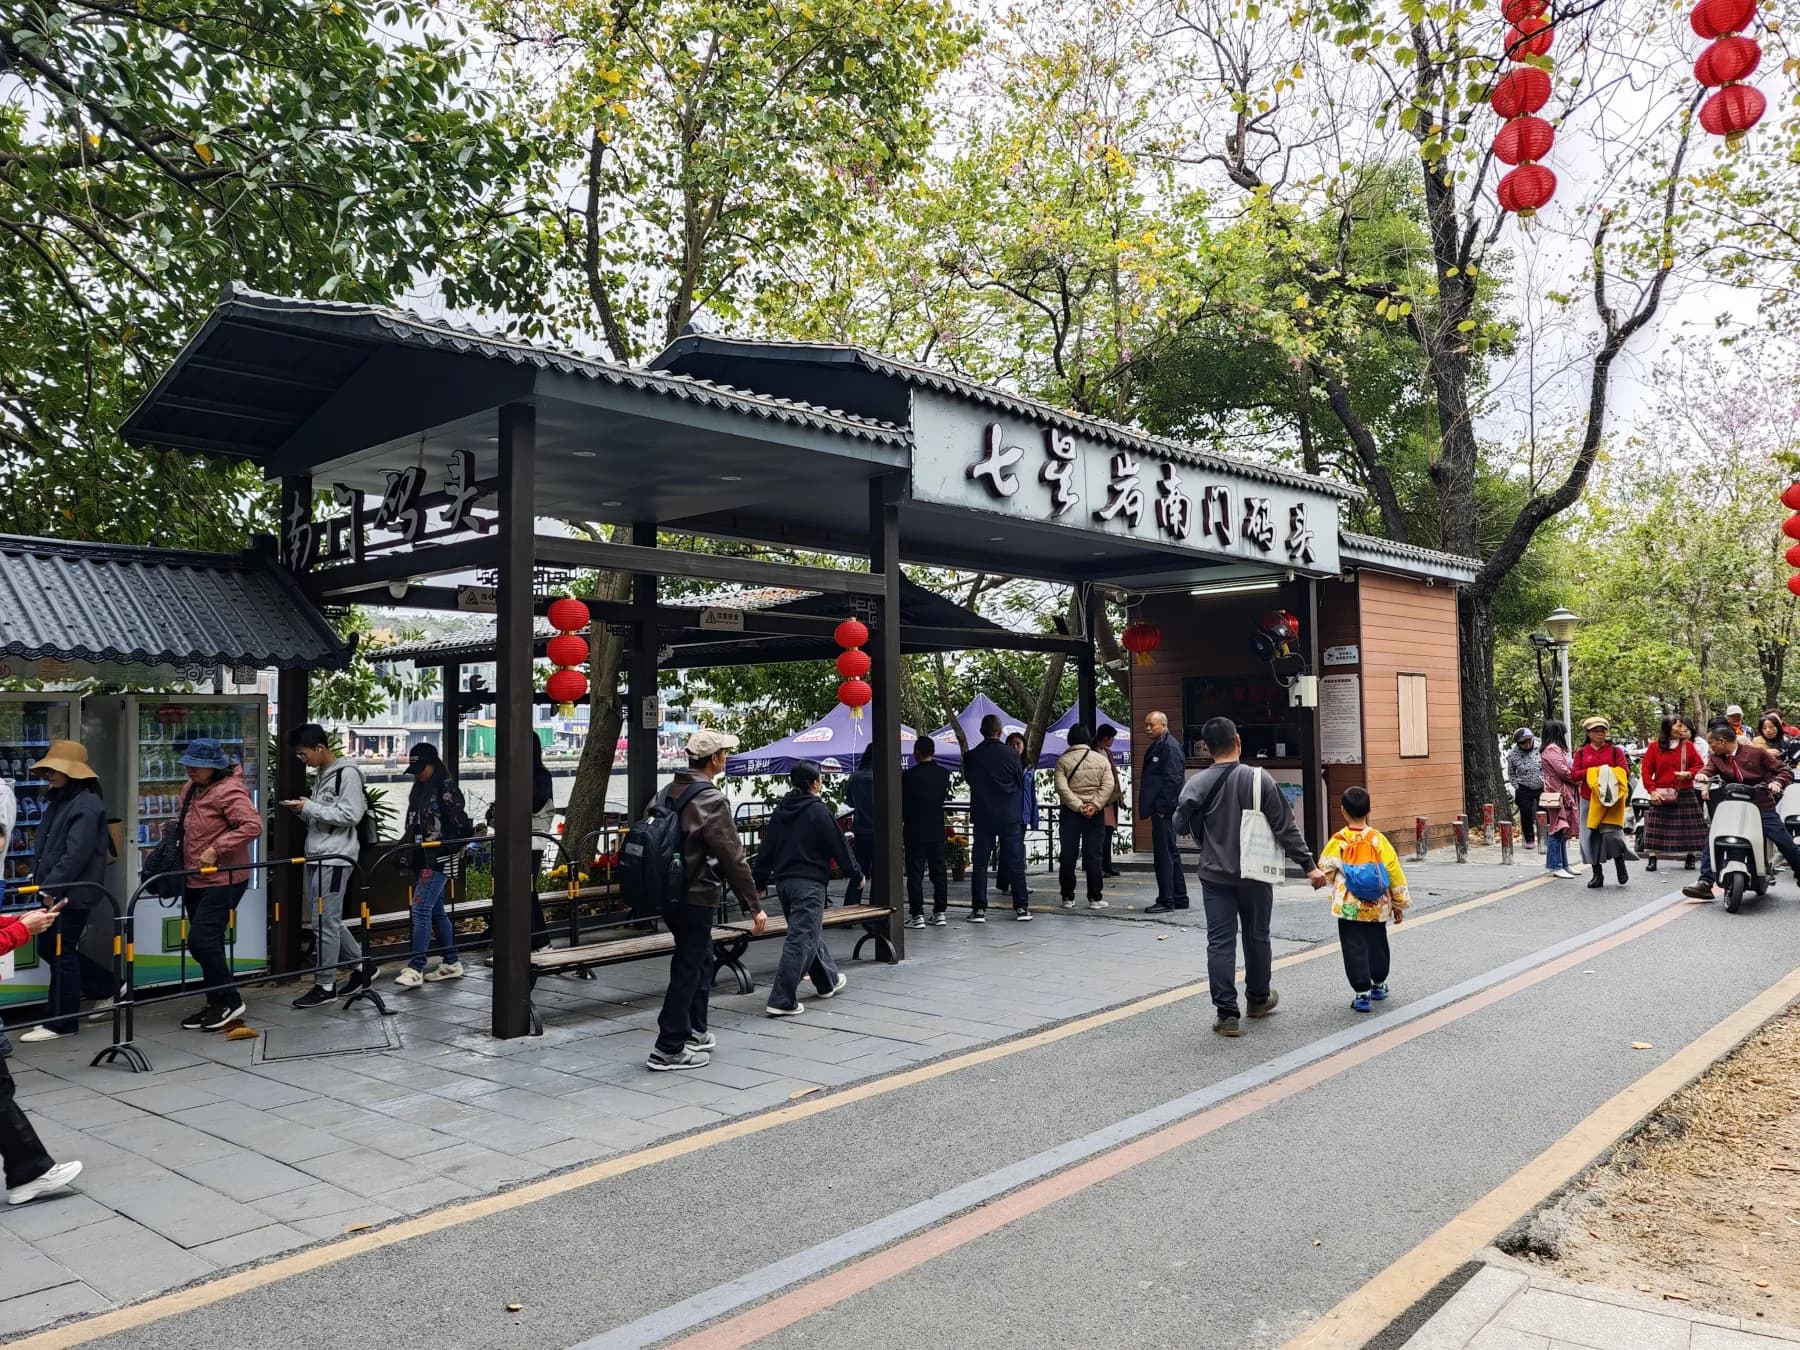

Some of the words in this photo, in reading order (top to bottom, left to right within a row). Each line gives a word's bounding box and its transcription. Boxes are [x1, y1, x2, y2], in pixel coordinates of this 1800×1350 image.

[284, 448, 490, 572] 南门码头
[967, 422, 1315, 564] 七星岩南门码头
